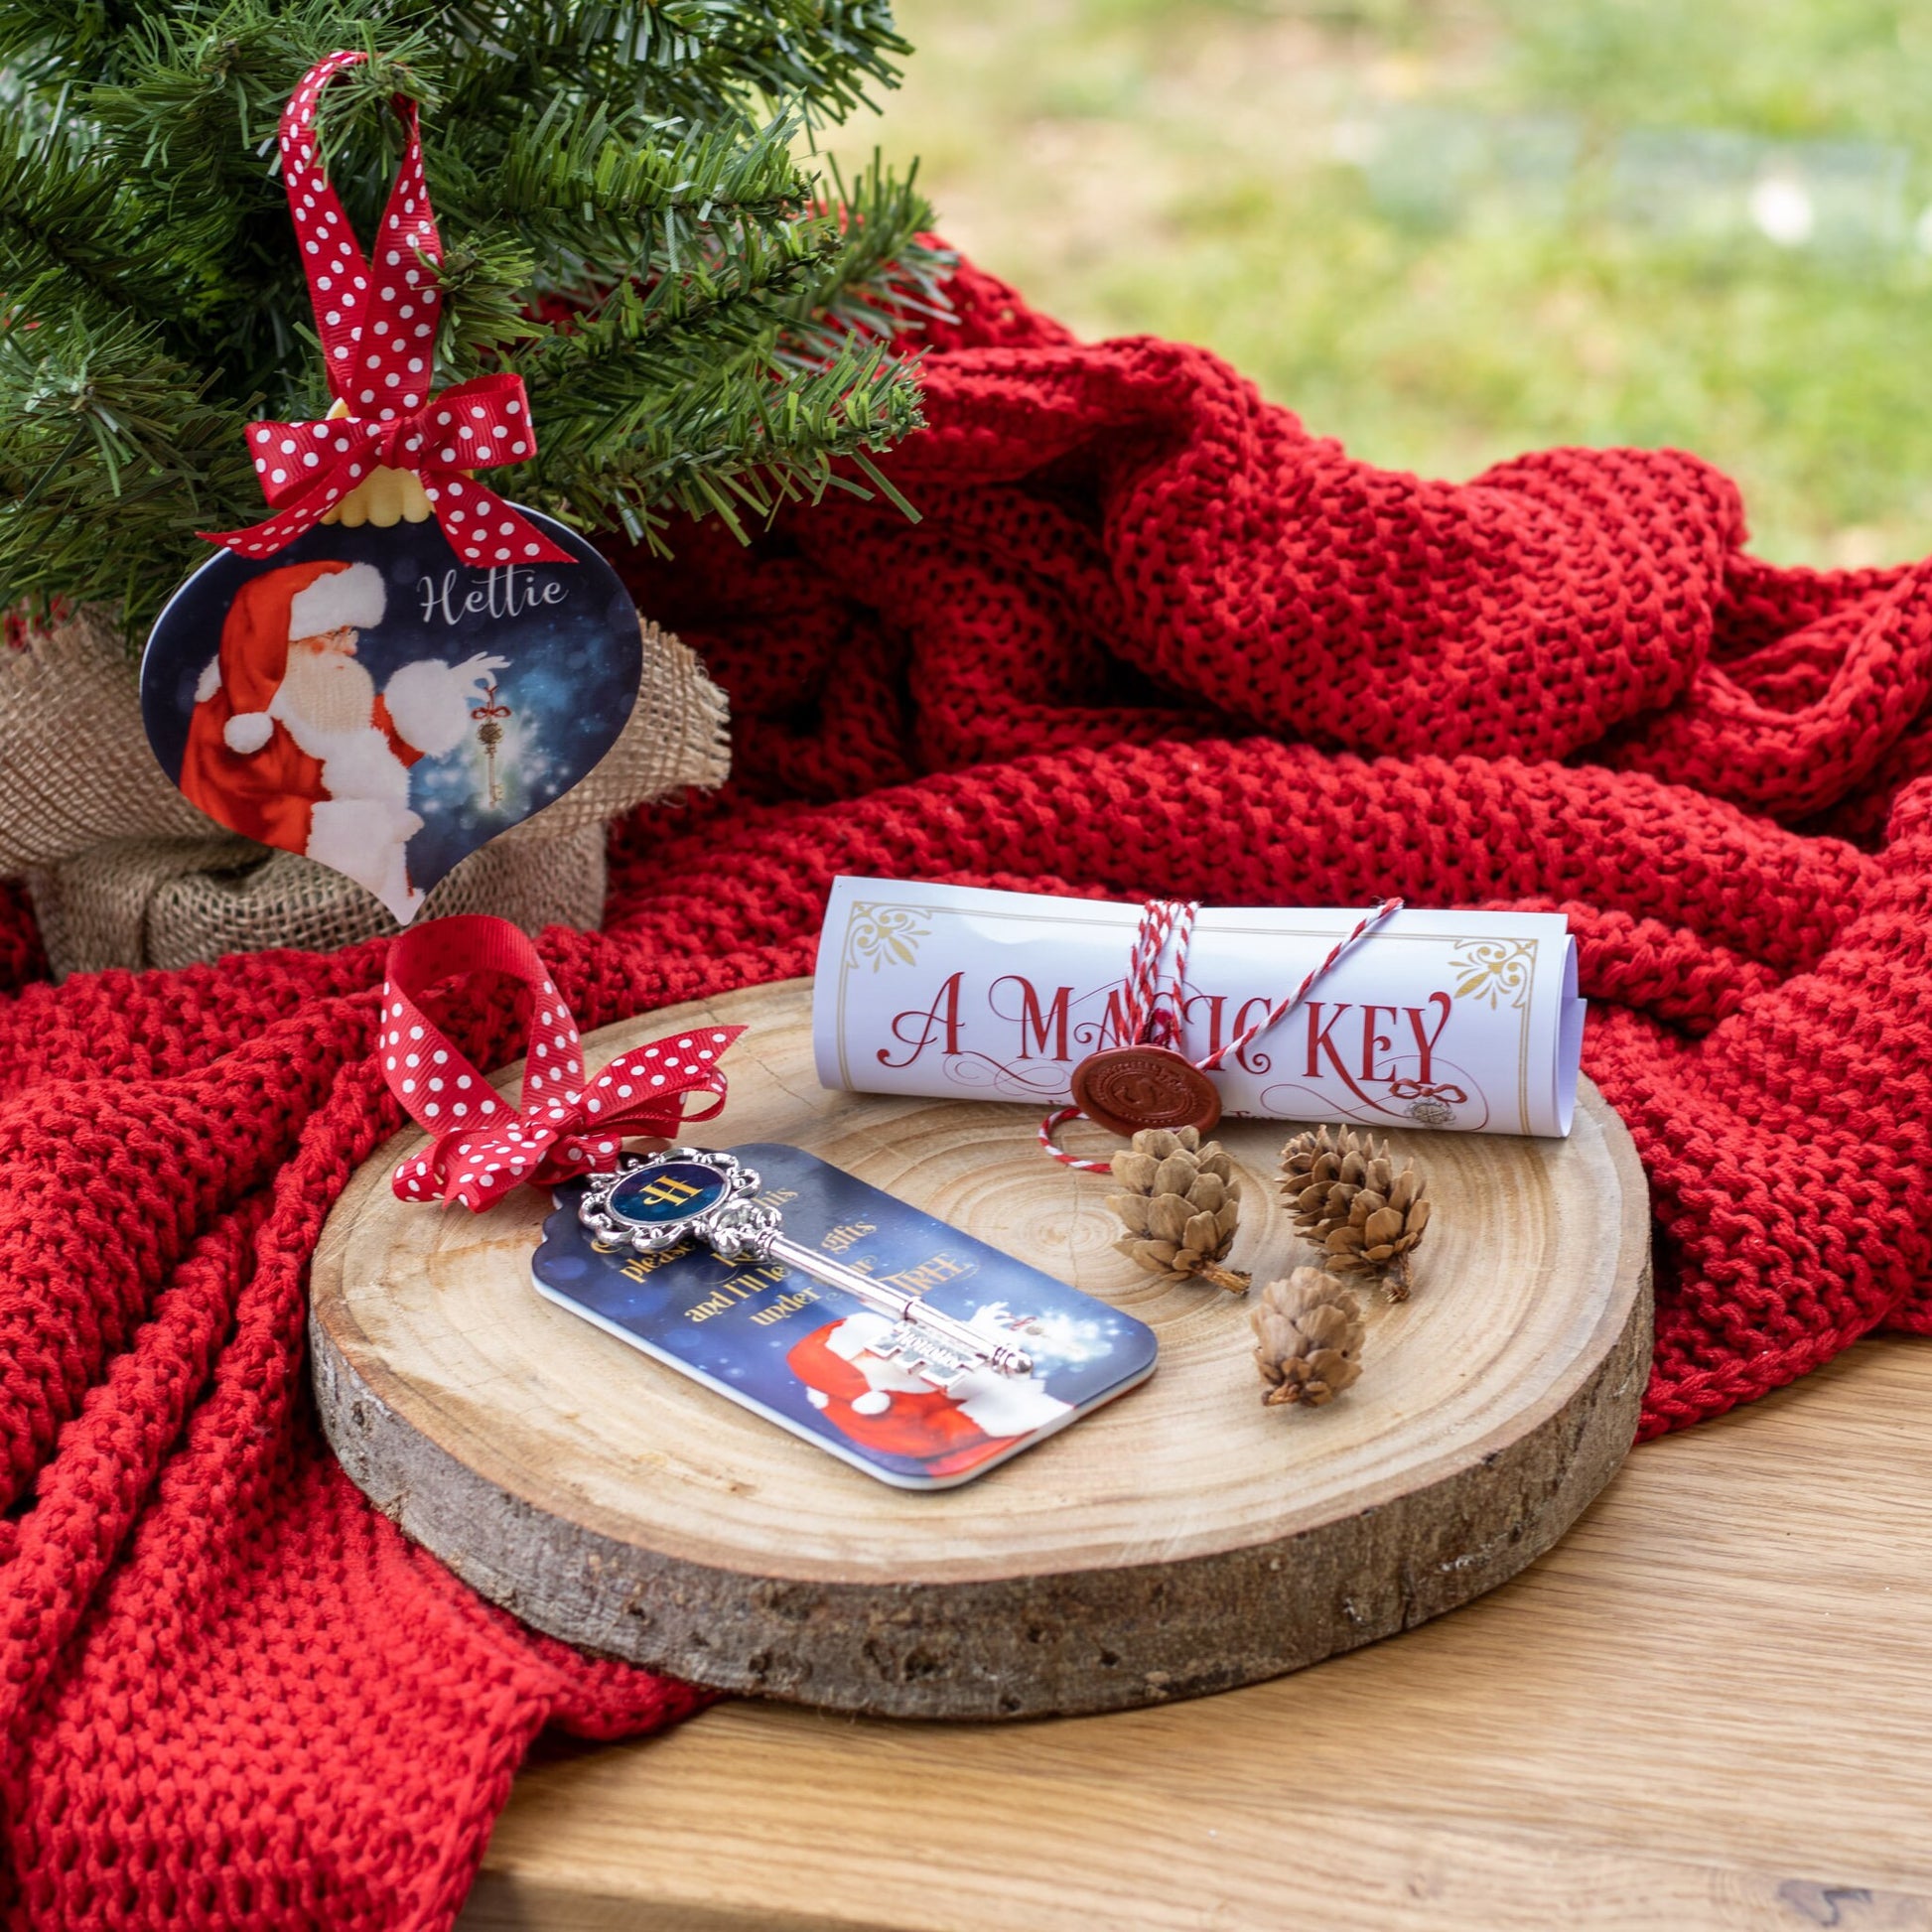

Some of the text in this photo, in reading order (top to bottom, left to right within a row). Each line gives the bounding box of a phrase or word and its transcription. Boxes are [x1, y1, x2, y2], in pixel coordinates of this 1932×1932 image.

[416, 564, 570, 625] Hettie
[877, 971, 966, 1068] A
[1301, 991, 1451, 1119] KEY
[638, 1174, 704, 1207] H
[751, 1187, 799, 1209] his
[684, 1221, 878, 1322] and I'll gifts
[874, 1249, 979, 1296] TREE
[749, 1287, 821, 1326] under
